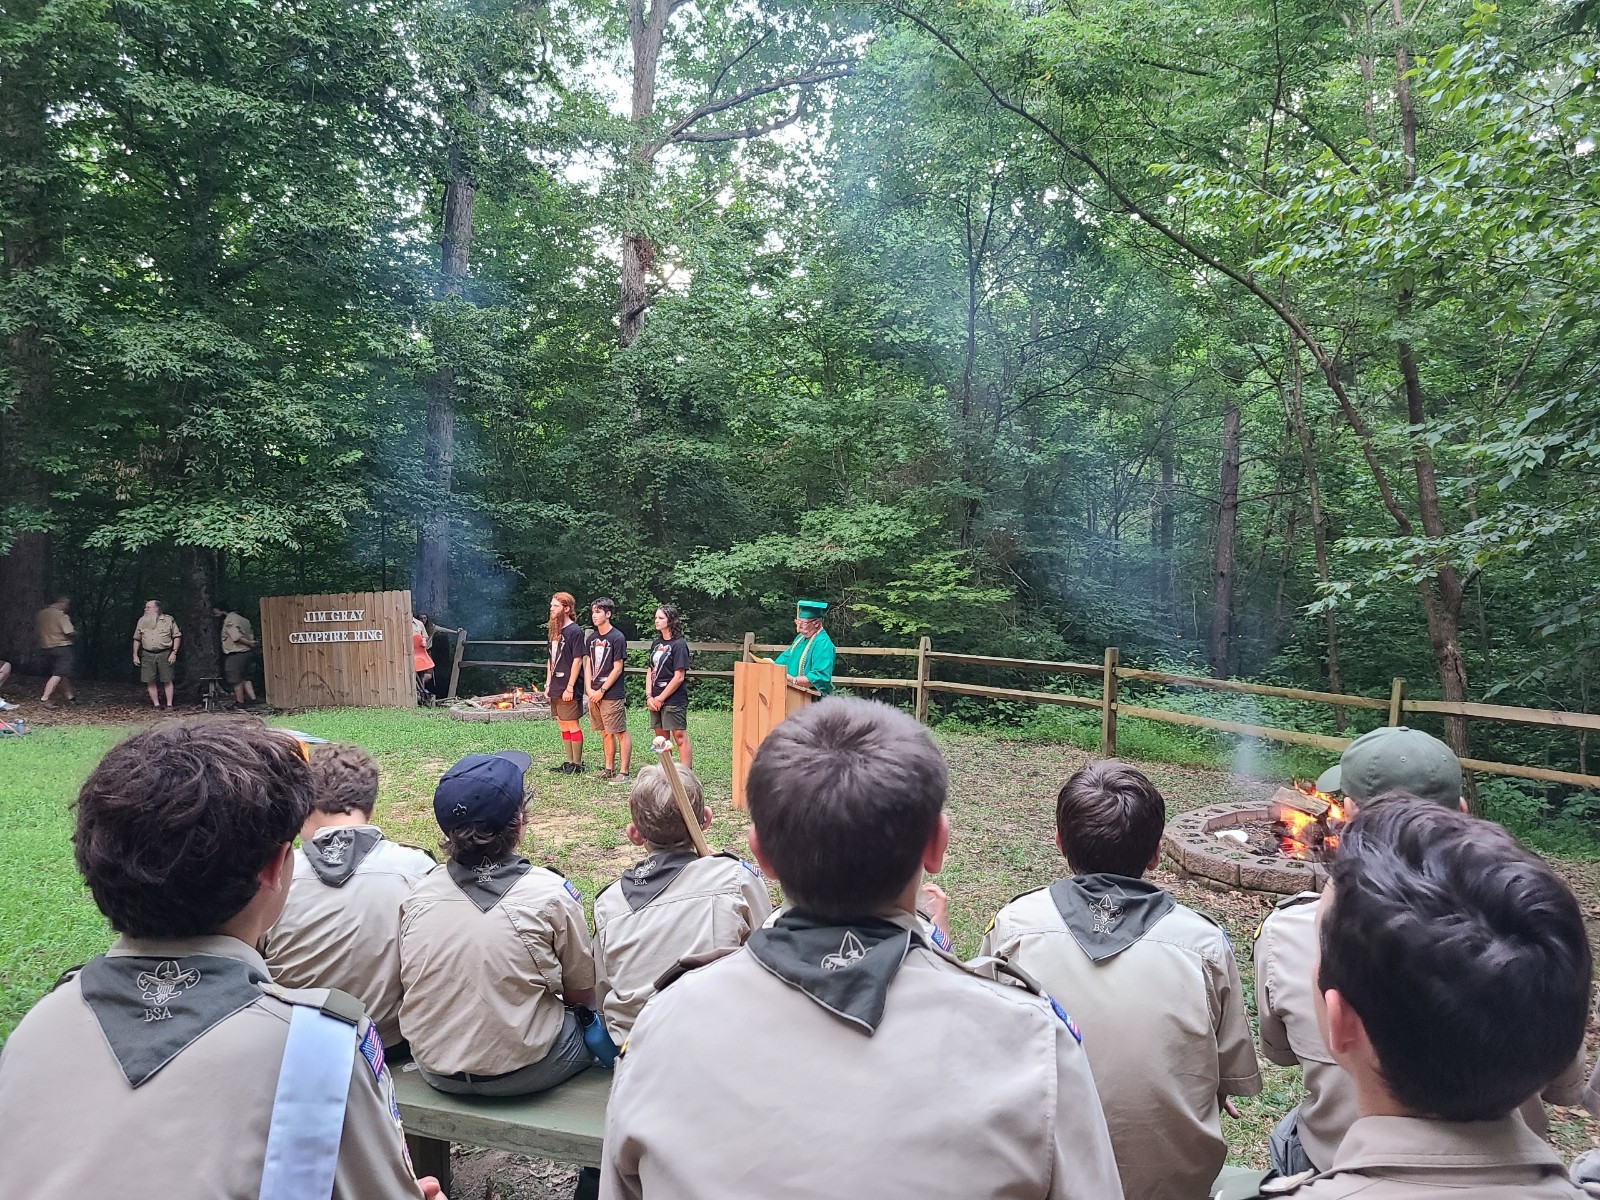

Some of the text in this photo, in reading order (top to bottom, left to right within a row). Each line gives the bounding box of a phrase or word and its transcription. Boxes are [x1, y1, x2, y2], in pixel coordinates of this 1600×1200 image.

[303, 609, 364, 622] JIM GRAY
[289, 630, 383, 643] CAMPFIRE RING
[633, 878, 648, 886] BSA
[1092, 923, 1111, 935] BSA
[143, 1006, 173, 1022] BSA
